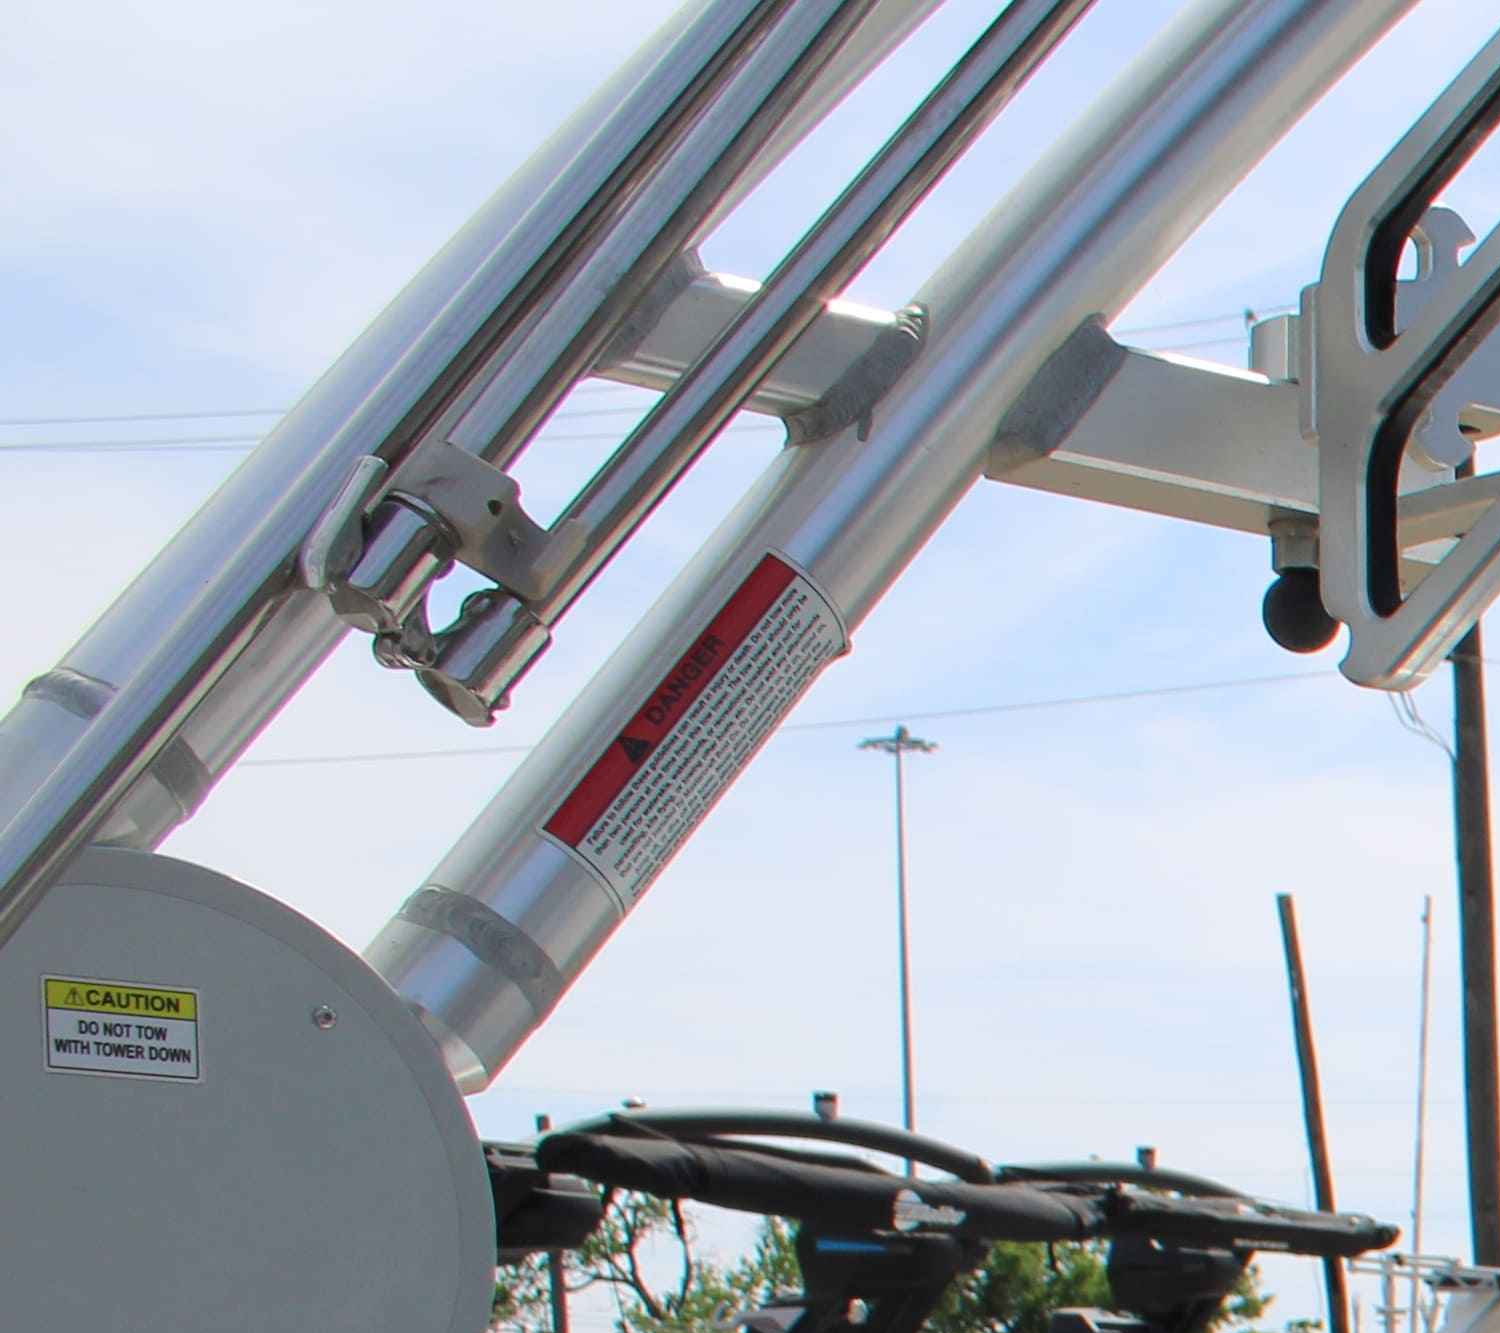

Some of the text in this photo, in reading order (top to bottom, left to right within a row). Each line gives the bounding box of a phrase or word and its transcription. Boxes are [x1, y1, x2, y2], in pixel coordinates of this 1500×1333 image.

[641, 630, 727, 728] DANGER
[86, 989, 181, 1013] CAUTION
[78, 1020, 168, 1041] DO NOT TOW
[54, 1039, 192, 1063] WITH TOWER DOWN
